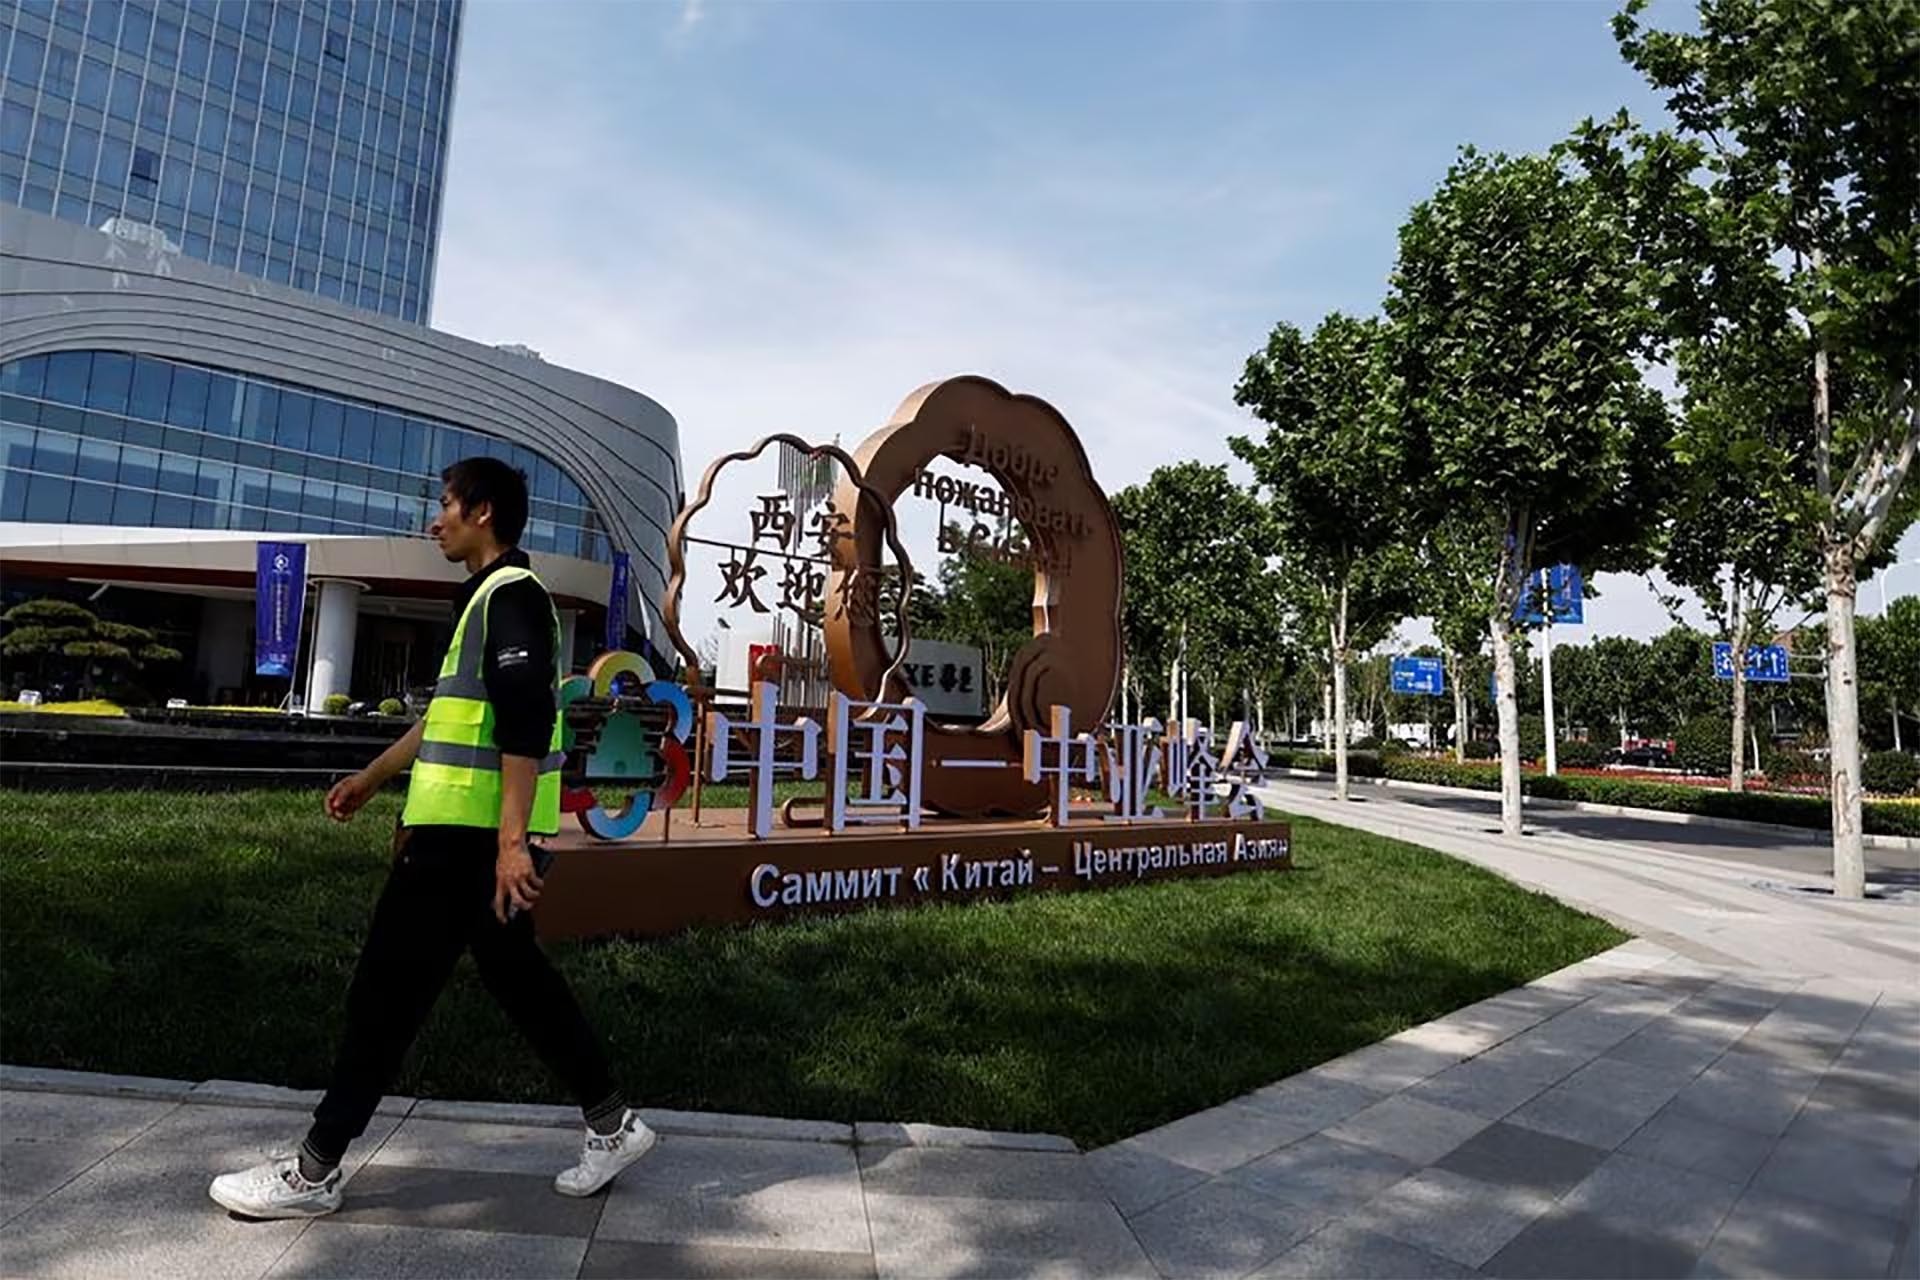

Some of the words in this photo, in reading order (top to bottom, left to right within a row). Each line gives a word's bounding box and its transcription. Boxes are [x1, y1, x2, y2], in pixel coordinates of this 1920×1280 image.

[750, 495, 857, 562] 西安
[751, 863, 902, 907] Саммит
[940, 849, 1033, 892] Китай
[1073, 840, 1228, 880] Центральная
